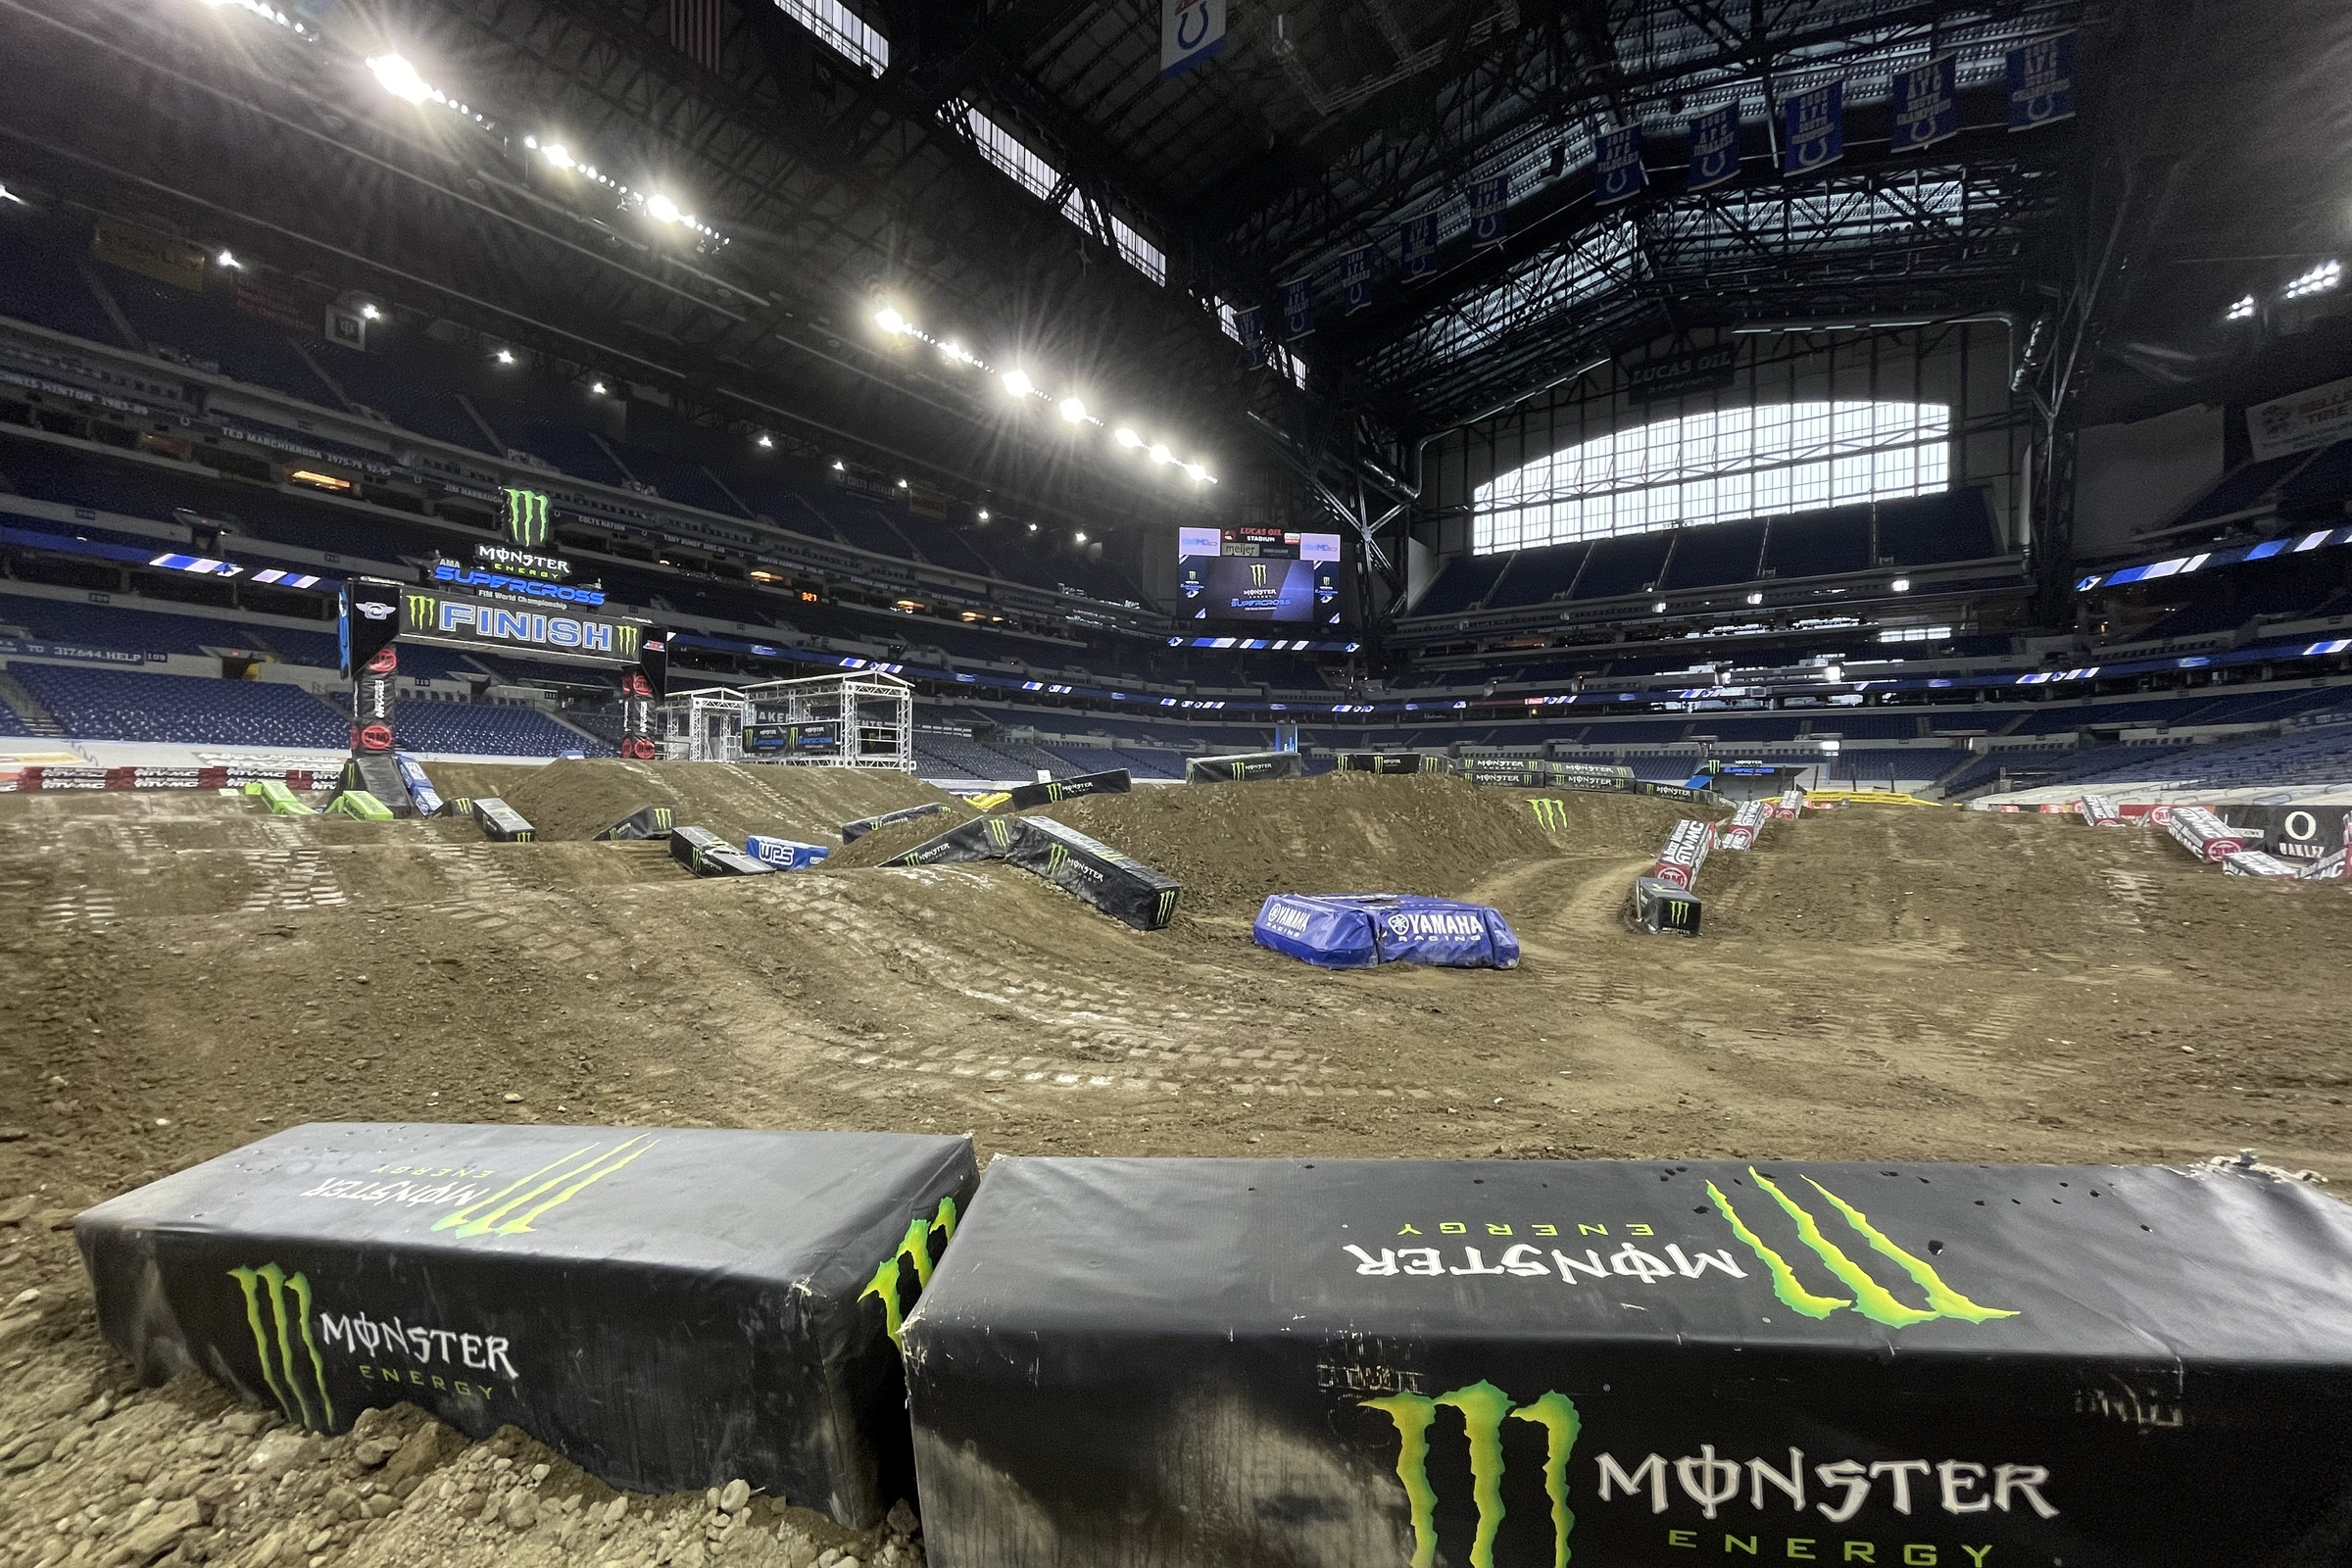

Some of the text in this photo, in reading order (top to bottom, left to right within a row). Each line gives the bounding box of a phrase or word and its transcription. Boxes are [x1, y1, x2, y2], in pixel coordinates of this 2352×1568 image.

[1631, 352, 1731, 384] LUCAS OIL
[222, 427, 244, 440] TED
[478, 545, 571, 574] MONSTER
[1226, 543, 1255, 556] meijer
[440, 559, 461, 568] AMA
[494, 564, 560, 579] ENERGY
[434, 565, 606, 607] SUPERCROSS
[495, 592, 515, 602] World
[517, 595, 567, 611] Championship
[439, 601, 612, 652] FINISH
[1476, 773, 1519, 782] MONSTER
[1566, 764, 1613, 773] MONSTER
[1062, 781, 1094, 792] MONSTER
[1569, 775, 1612, 785] MONSTER
[1656, 786, 1691, 797] MONSTER
[759, 842, 795, 866] WPS
[919, 843, 951, 861] MONSTER
[1066, 857, 1104, 882] MONSTER
[1279, 906, 1311, 932] YAMAHA
[1408, 913, 1485, 935] YAMAHA
[1266, 922, 1300, 938] RACING
[371, 1166, 494, 1179] ENERGY
[301, 1176, 491, 1208] MONSTER
[1396, 1221, 1656, 1238] ENERGY
[1343, 1242, 1750, 1285] MONSTER
[320, 1311, 520, 1381] MONSTER
[359, 1364, 494, 1401] ENERGY
[1595, 1443, 2060, 1523] MONSTER
[1669, 1529, 1993, 1568] ENERGY
